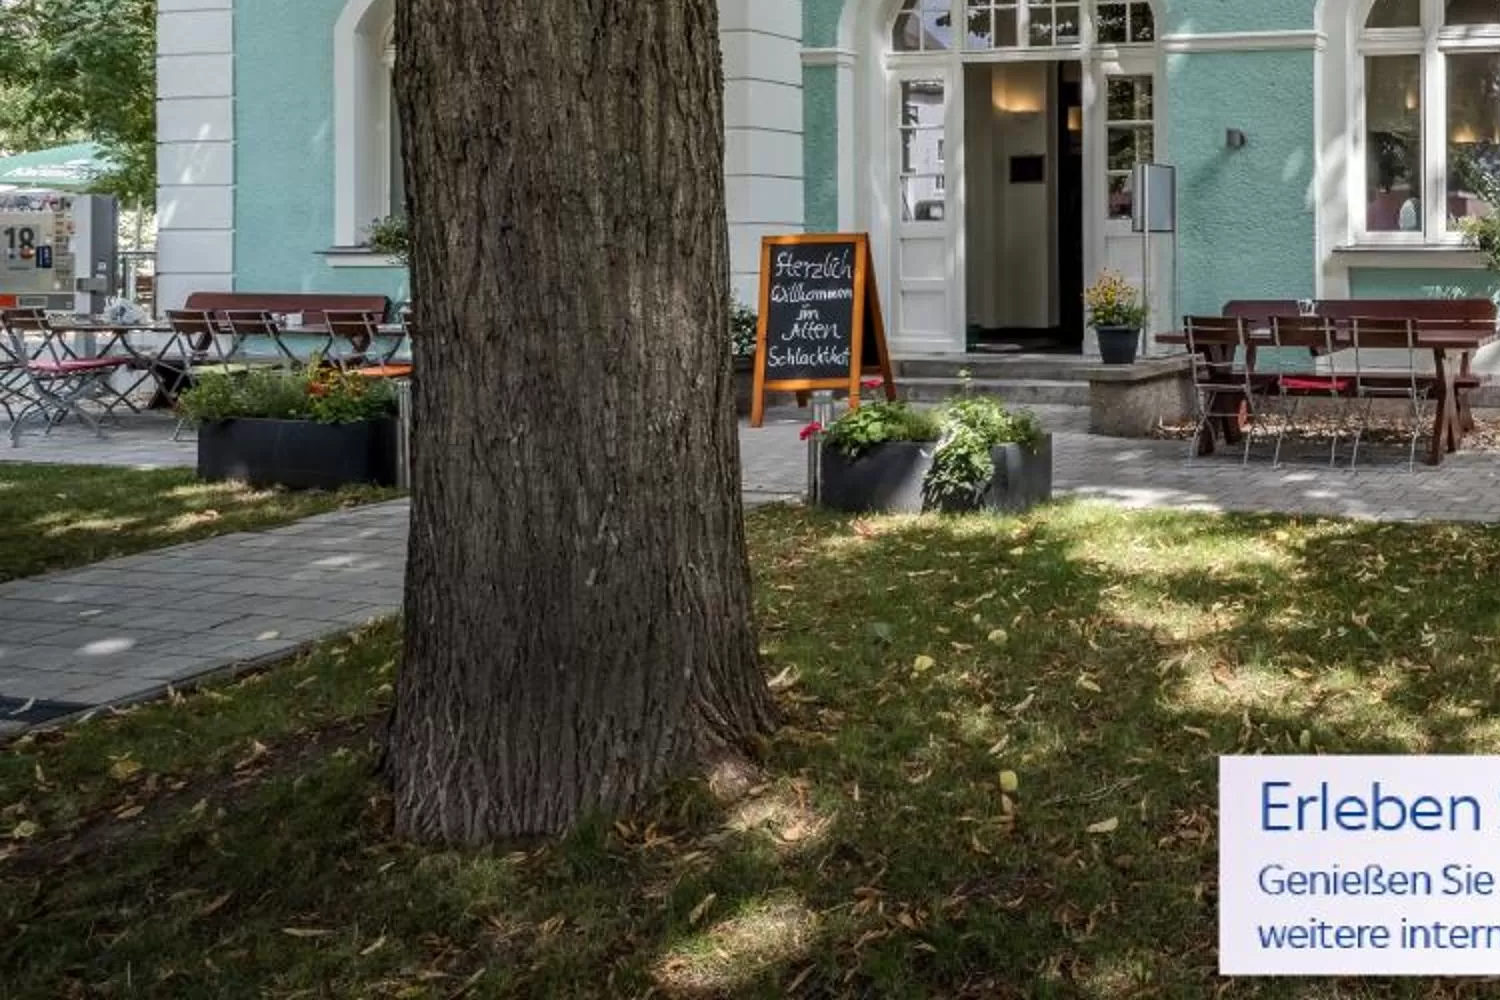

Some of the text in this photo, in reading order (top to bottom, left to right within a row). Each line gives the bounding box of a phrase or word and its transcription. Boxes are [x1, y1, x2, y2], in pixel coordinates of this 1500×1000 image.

[775, 248, 852, 279] Herzlich
[771, 282, 853, 303] Willkommen
[796, 303, 819, 321] im
[781, 321, 842, 341] Alten
